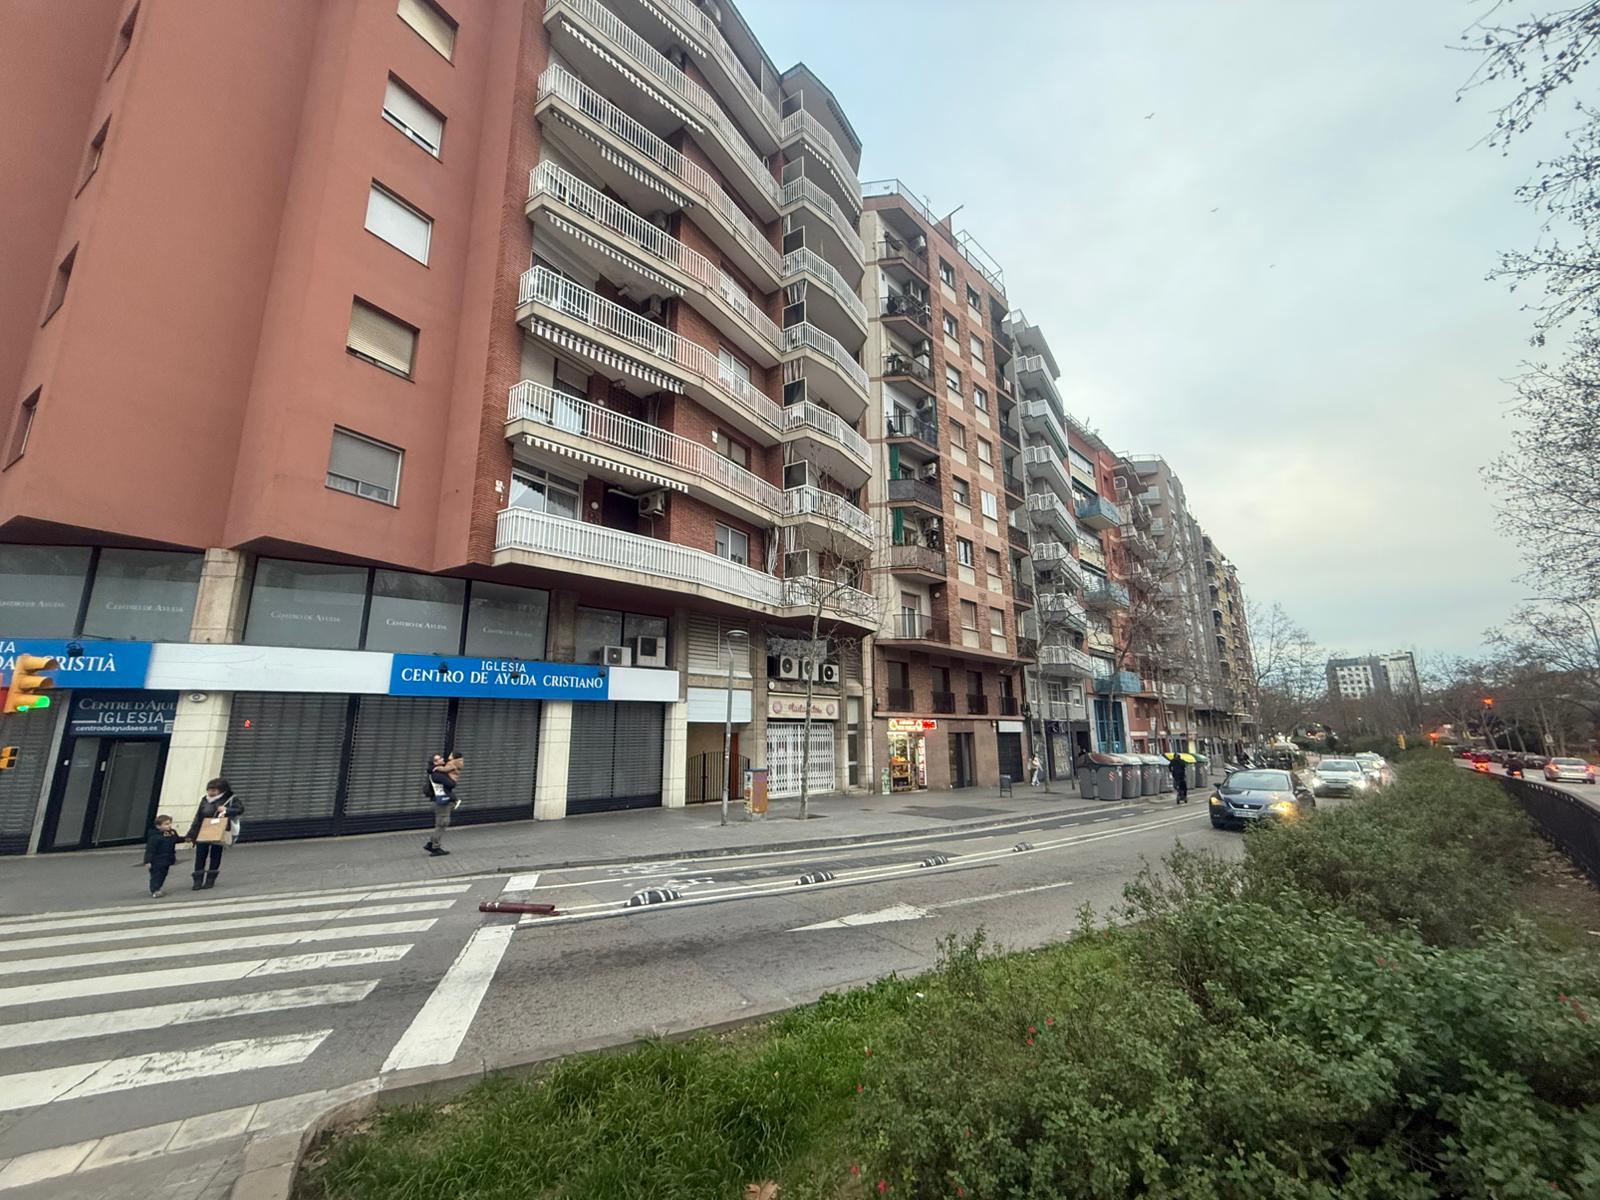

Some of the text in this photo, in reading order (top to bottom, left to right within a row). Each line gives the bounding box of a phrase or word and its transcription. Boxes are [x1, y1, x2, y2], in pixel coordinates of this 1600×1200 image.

[42, 653, 116, 672] RISTIÀ
[481, 660, 526, 673] IGLESIA
[401, 668, 464, 683] CENTRO
[470, 671, 489, 684] DE
[543, 675, 603, 689] CRISTIANO
[79, 698, 130, 710] CENTRE
[97, 711, 164, 724] IGLESIA
